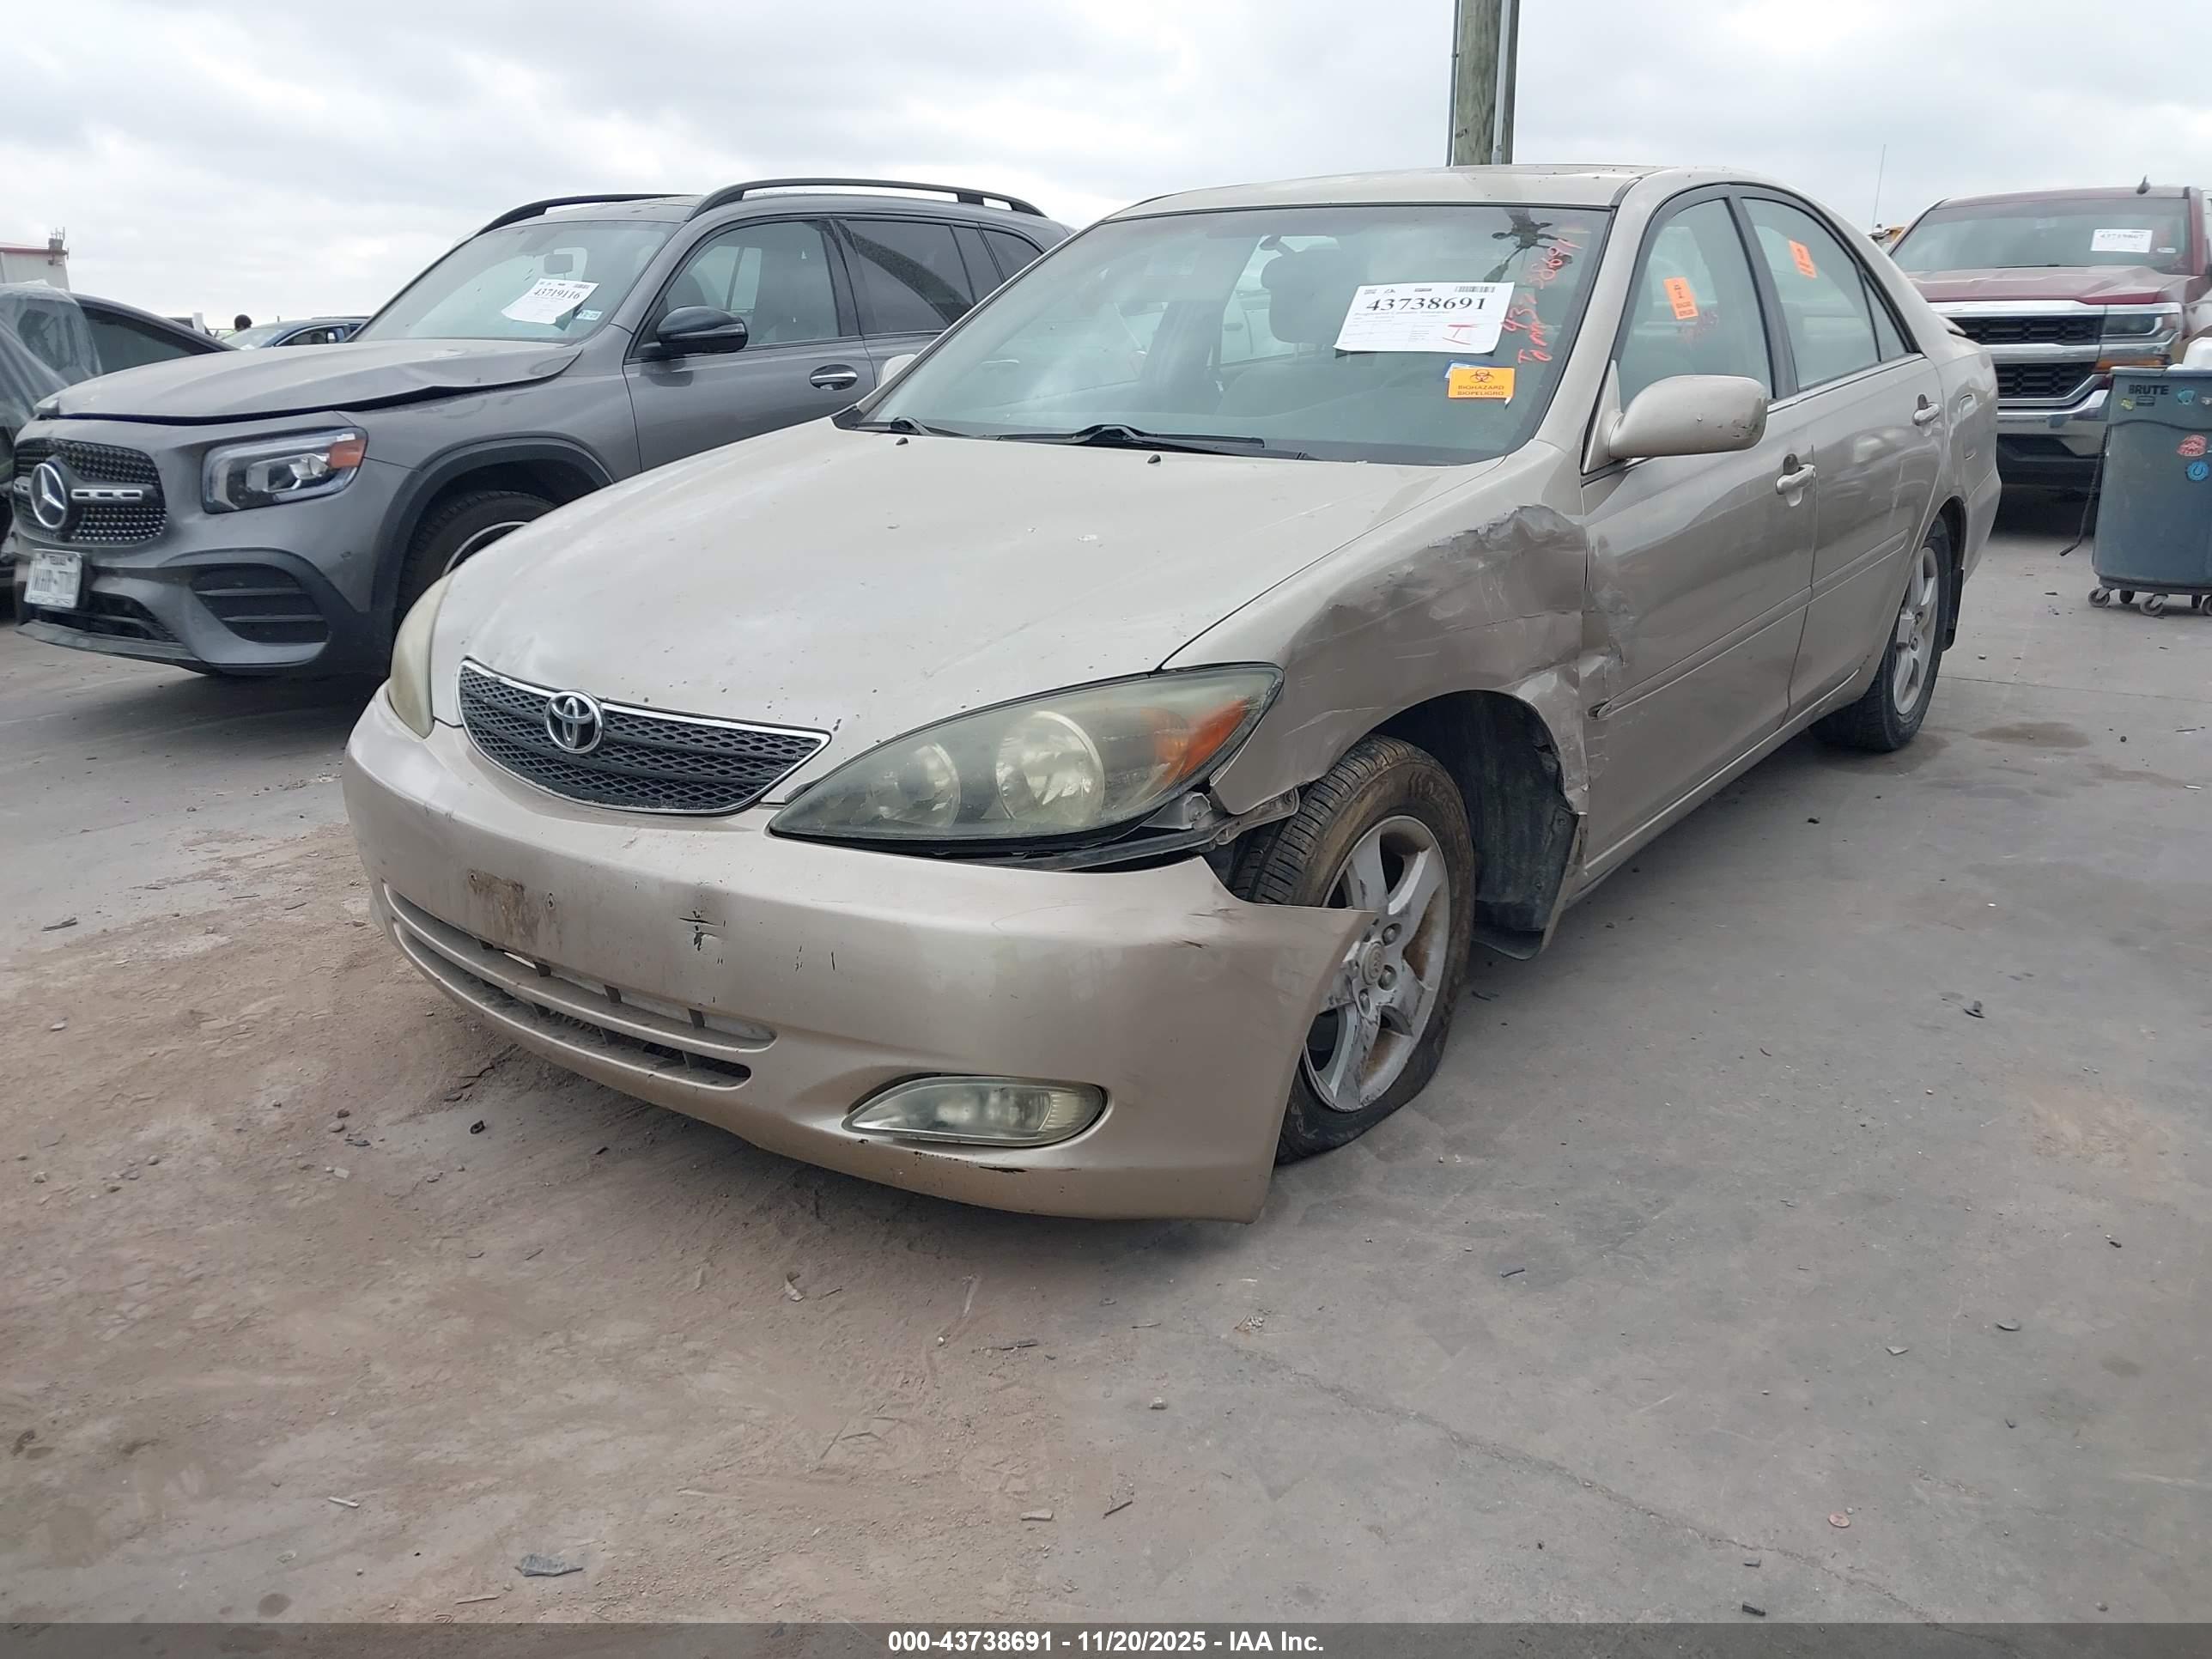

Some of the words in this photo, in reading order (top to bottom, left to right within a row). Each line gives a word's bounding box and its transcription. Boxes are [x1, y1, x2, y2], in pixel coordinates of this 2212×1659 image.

[534, 288, 580, 300] 43719116
[1366, 297, 1486, 311] 43738691
[2129, 384, 2170, 395] BRUTE
